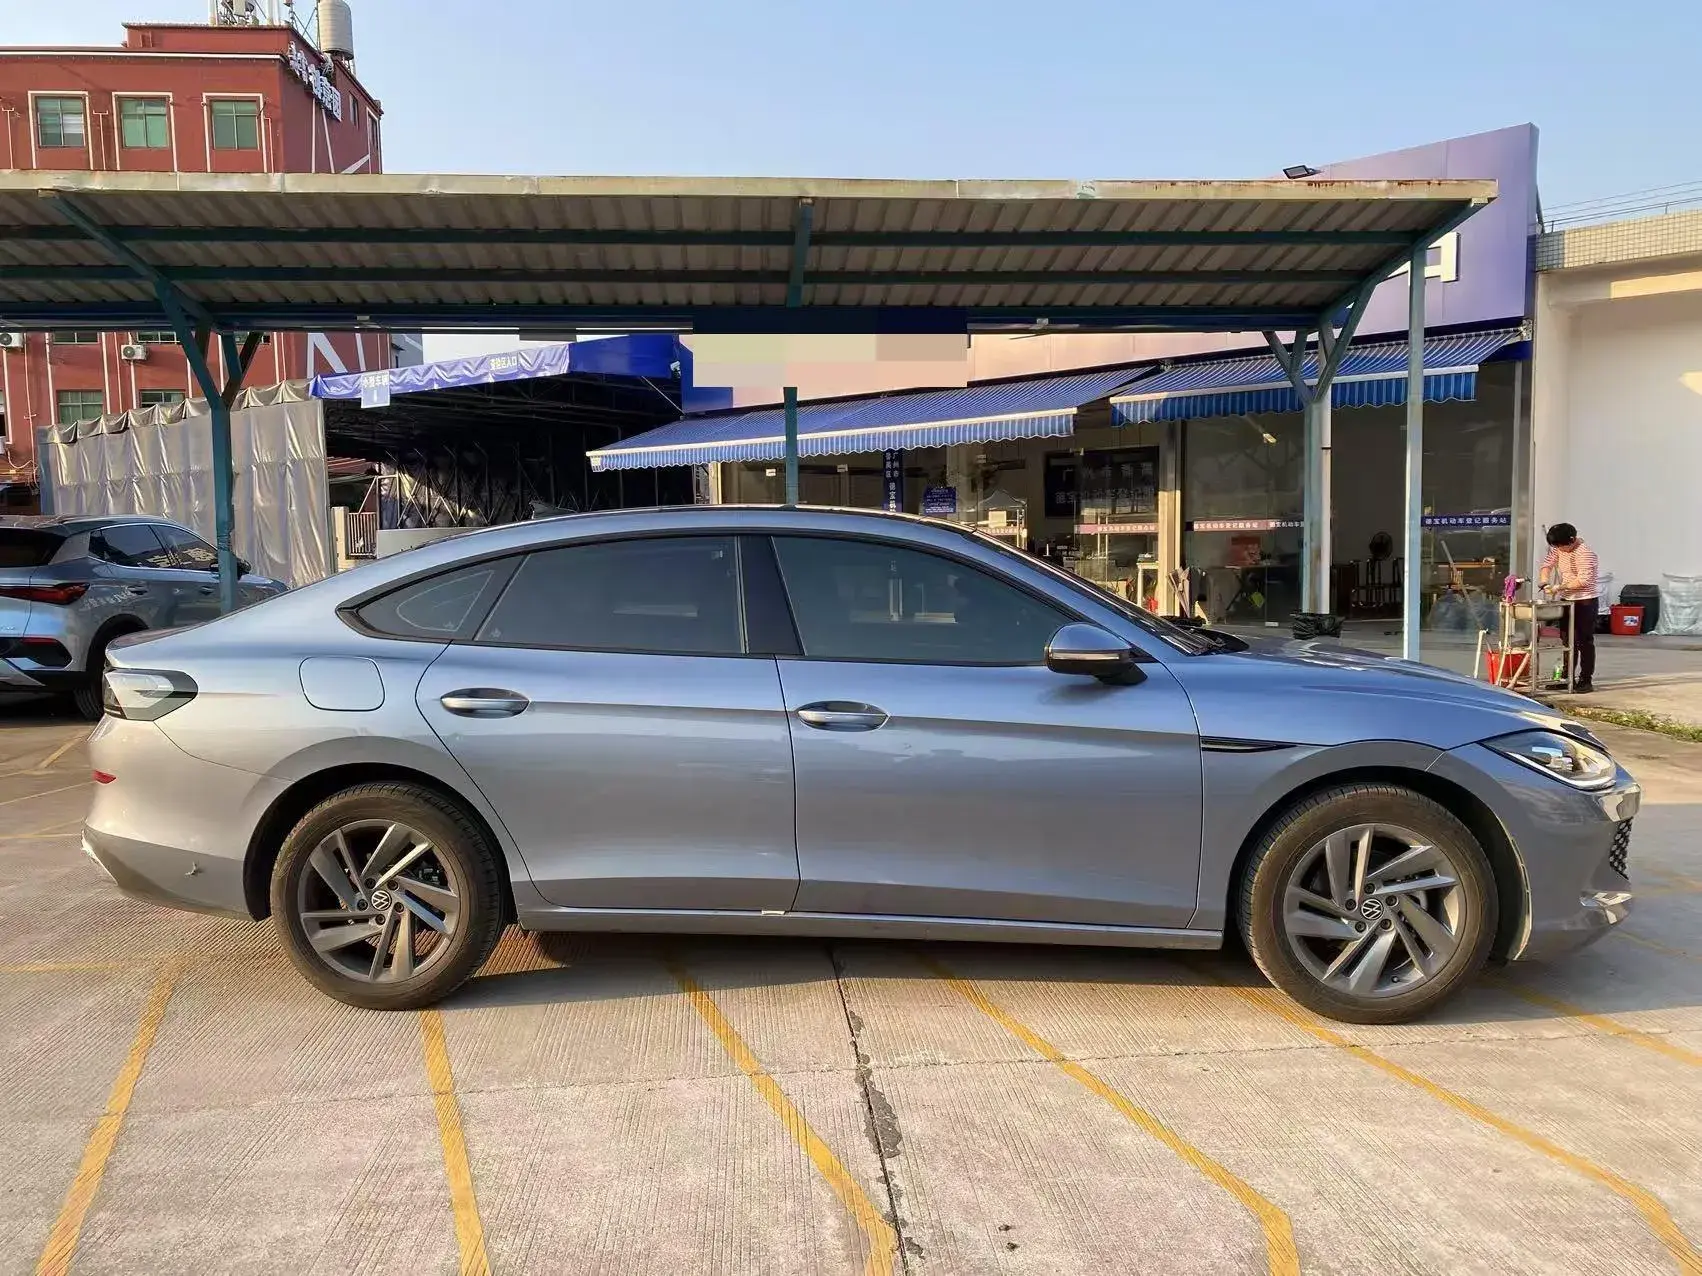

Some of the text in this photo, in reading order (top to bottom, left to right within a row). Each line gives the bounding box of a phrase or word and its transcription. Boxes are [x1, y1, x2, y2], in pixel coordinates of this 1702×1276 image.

[1193, 521, 1259, 529] 德宝机动车登记服务站
[1425, 517, 1507, 525] 德宝机动车登记服务站
